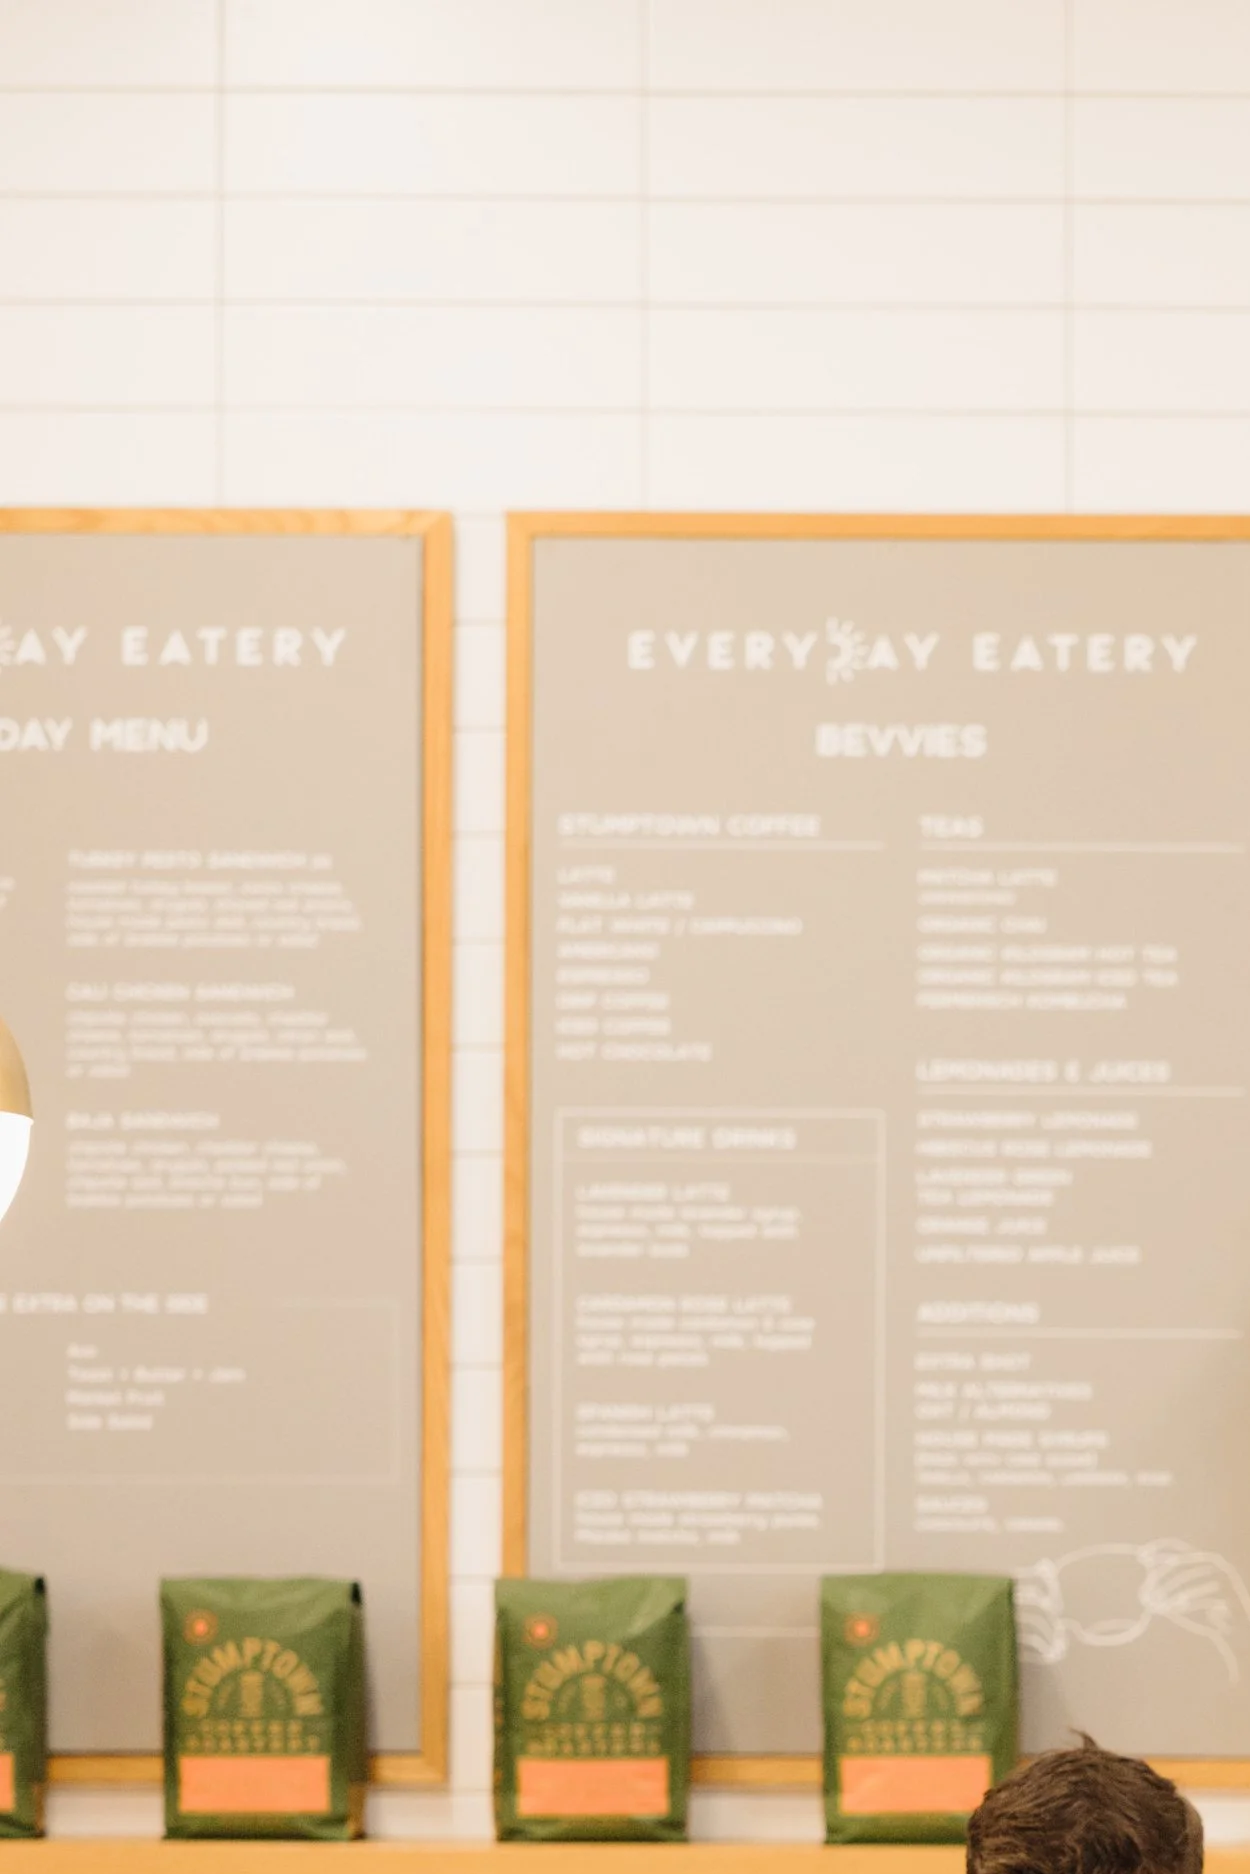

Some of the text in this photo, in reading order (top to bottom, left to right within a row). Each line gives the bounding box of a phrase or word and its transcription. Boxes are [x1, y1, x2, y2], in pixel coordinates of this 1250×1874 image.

[0, 622, 346, 668] AY EATERY
[628, 619, 1198, 683] EVERYDAY EATERY
[90, 718, 208, 753] MENU
[817, 725, 987, 758] BEVVIES
[557, 813, 821, 836] STUMPTOWN COFFEE
[918, 814, 984, 838] TEAS
[1089, 1058, 1172, 1083] JUICES
[576, 1125, 798, 1149] SIGNATURE DRINKS
[916, 1301, 1041, 1325] ADDITIONS
